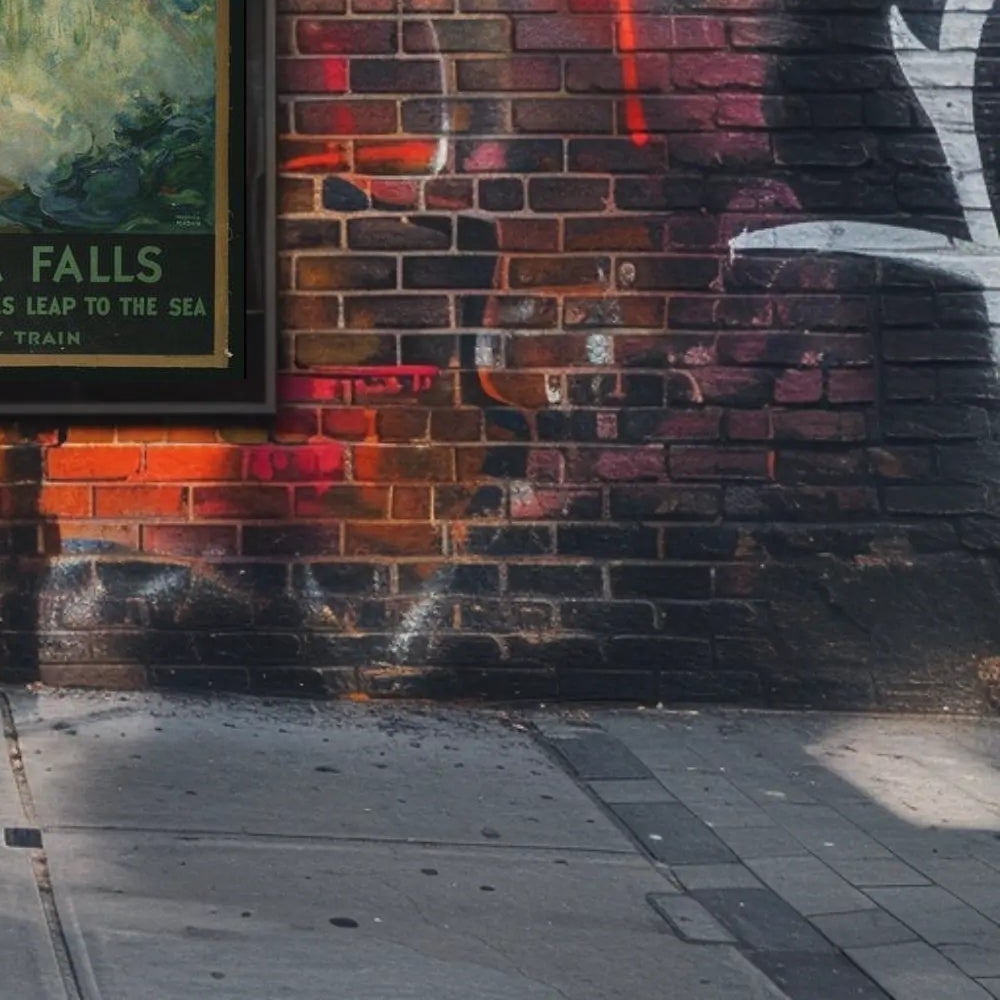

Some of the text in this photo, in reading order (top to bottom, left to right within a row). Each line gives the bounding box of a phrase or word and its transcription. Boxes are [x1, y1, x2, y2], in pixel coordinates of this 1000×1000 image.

[32, 244, 163, 283] FALLS
[26, 297, 77, 316] LEAP
[84, 297, 111, 317] TO
[119, 297, 158, 317] THE
[168, 297, 207, 317] SEA
[14, 330, 81, 346] TRAIN
